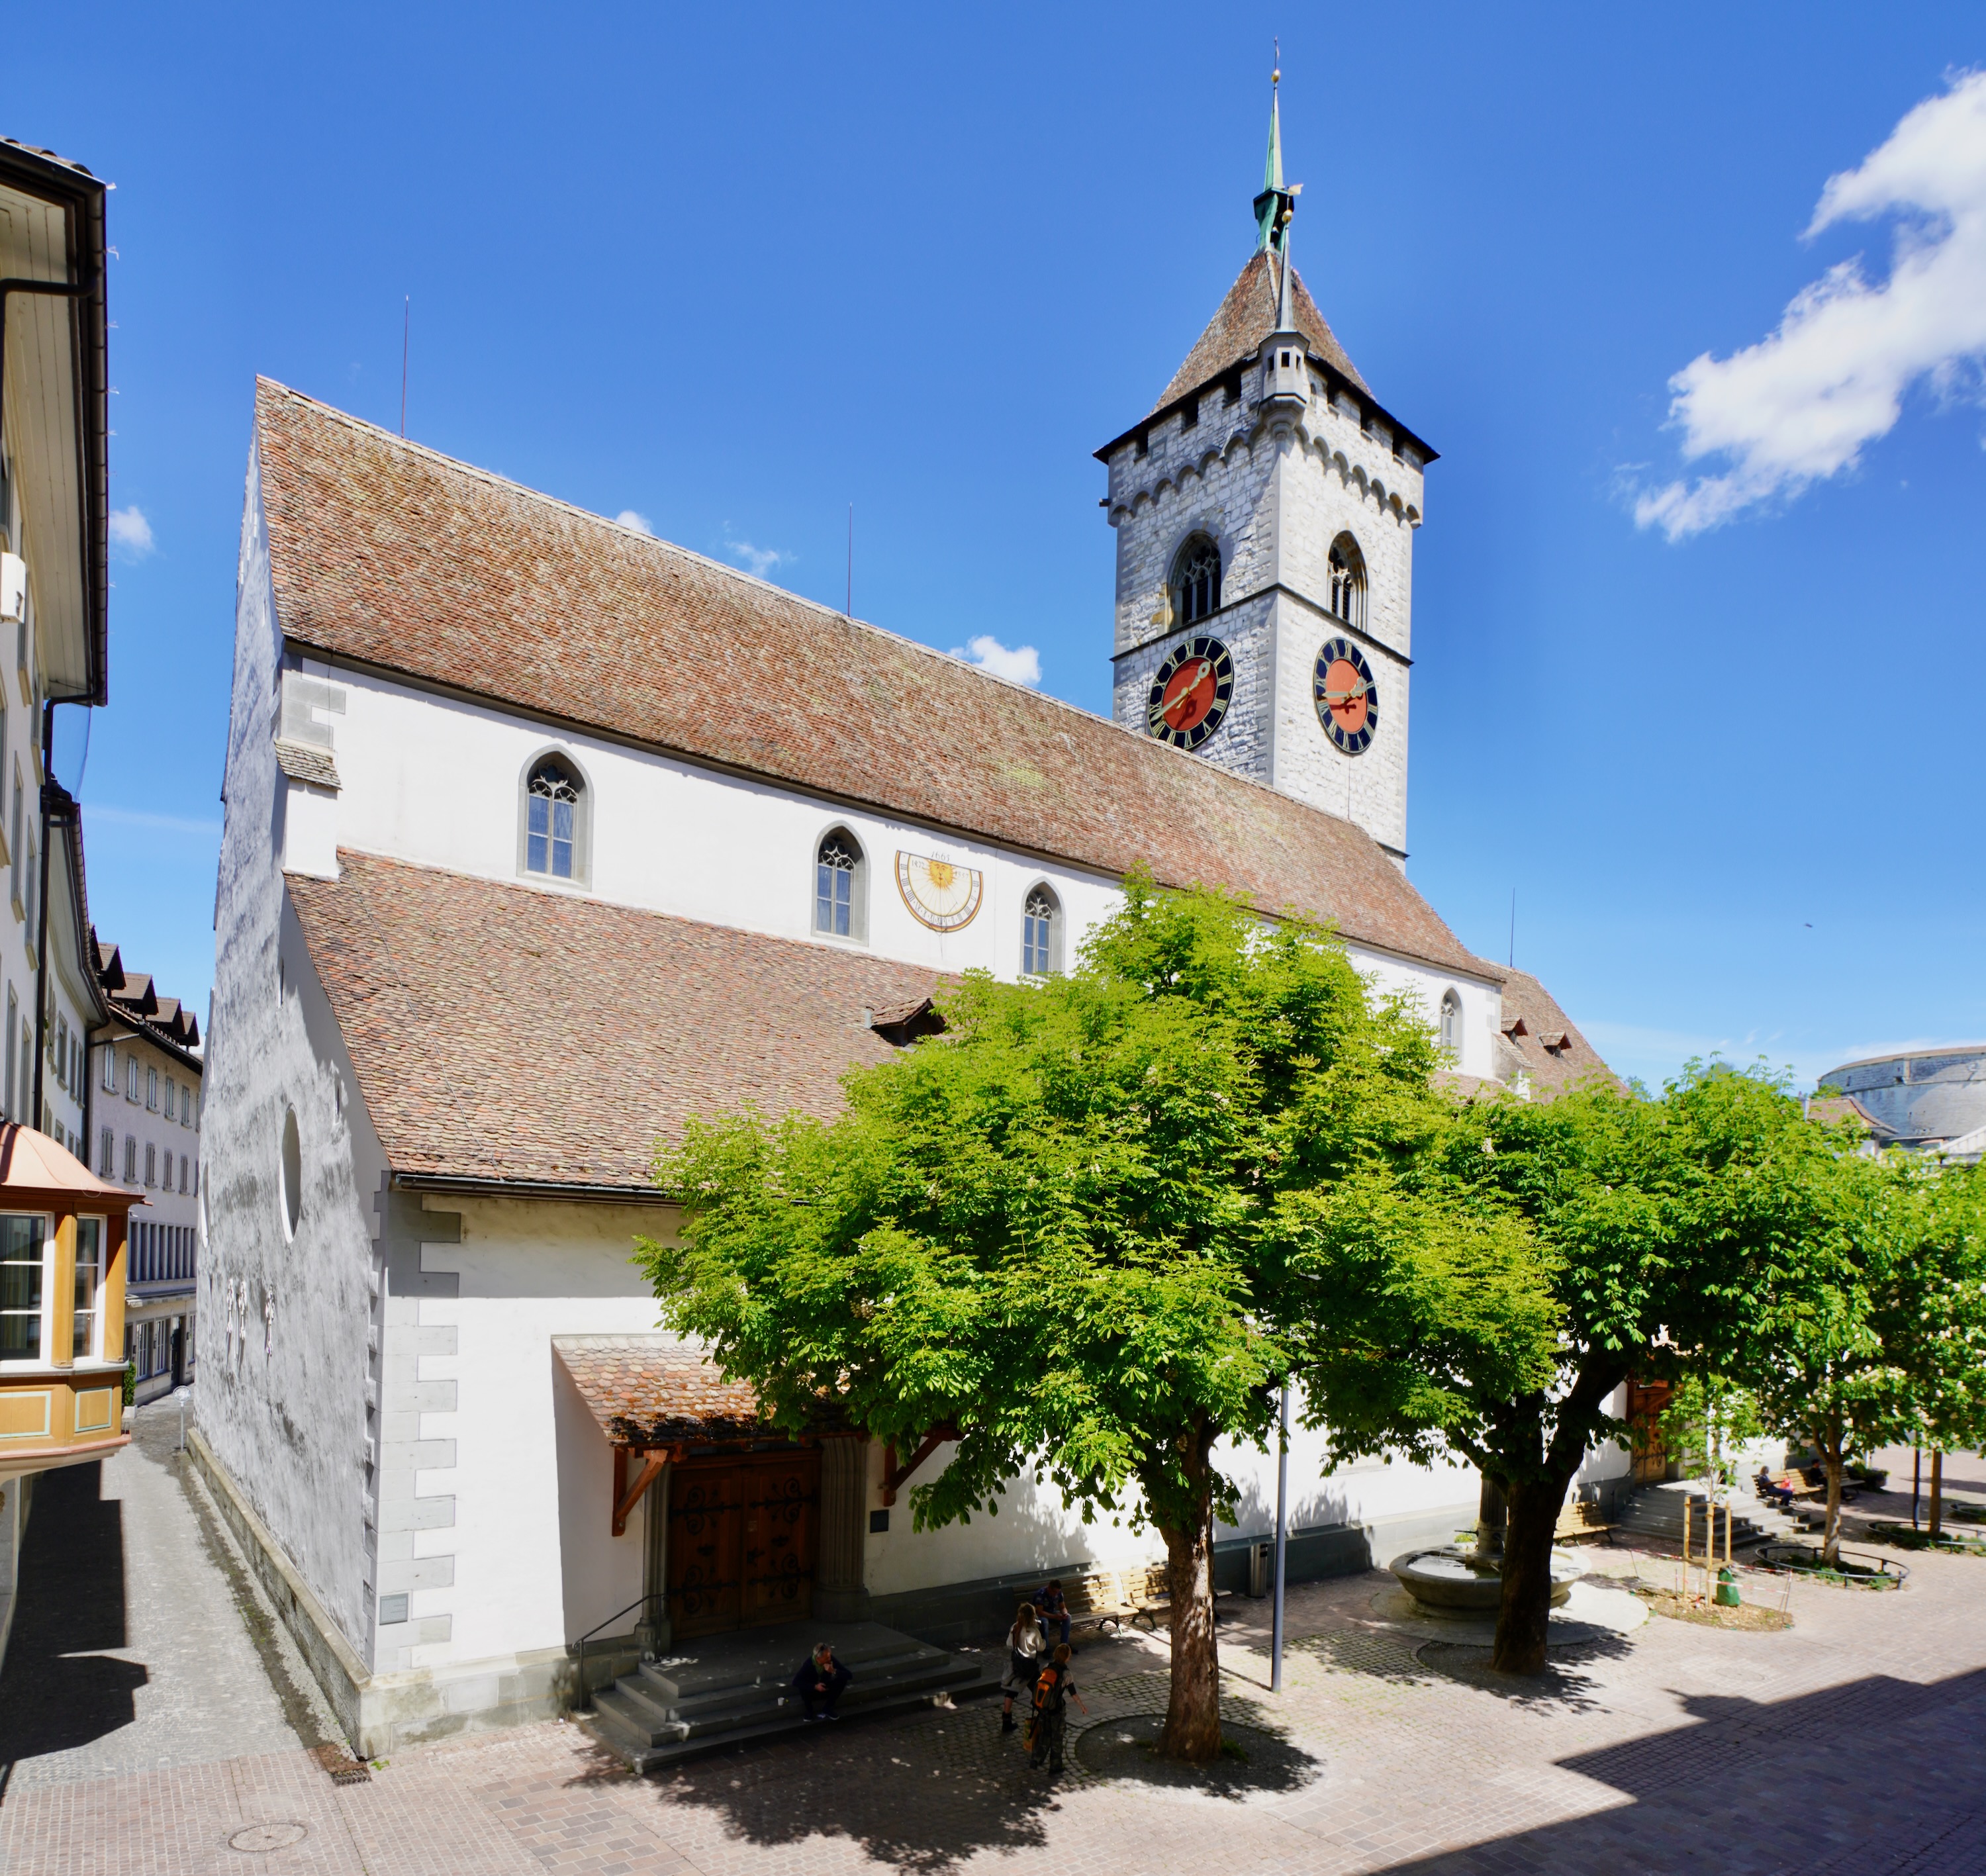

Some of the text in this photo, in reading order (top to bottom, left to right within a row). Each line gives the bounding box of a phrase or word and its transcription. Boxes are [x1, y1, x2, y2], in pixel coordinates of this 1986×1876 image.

[1184, 639, 1196, 659] XII
[1203, 639, 1212, 656] I
[1166, 653, 1178, 672] XI
[1213, 649, 1228, 667] II
[1154, 678, 1166, 690] X
[1217, 672, 1231, 686] III
[1202, 721, 1213, 735] V
